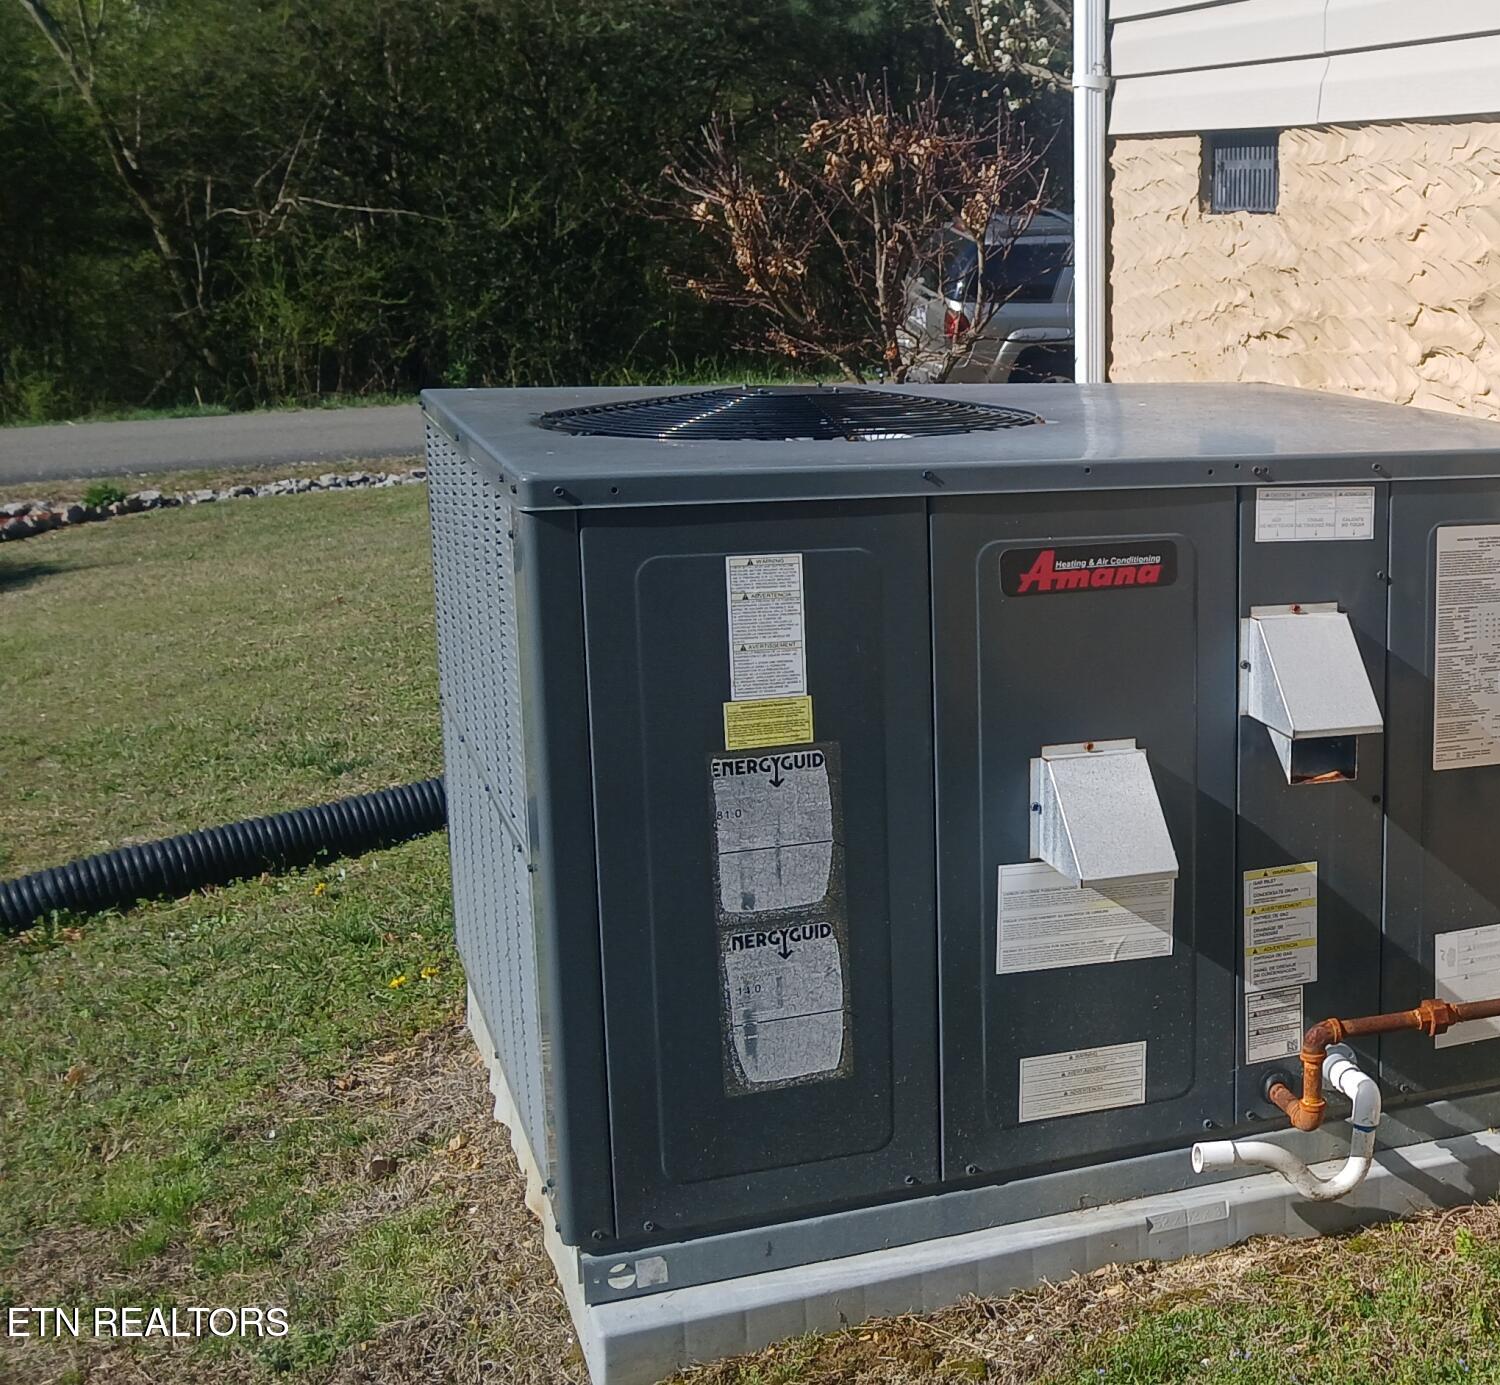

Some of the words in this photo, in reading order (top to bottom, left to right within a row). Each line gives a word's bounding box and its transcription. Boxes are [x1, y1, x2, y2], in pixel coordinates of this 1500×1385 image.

[1017, 550, 1162, 592] Amana
[1055, 559, 1087, 569] Heating
[1089, 558, 1095, 567] &
[1096, 557, 1109, 566] Air
[1110, 554, 1161, 565] Conditioning
[730, 924, 832, 952] NERGYGUID
